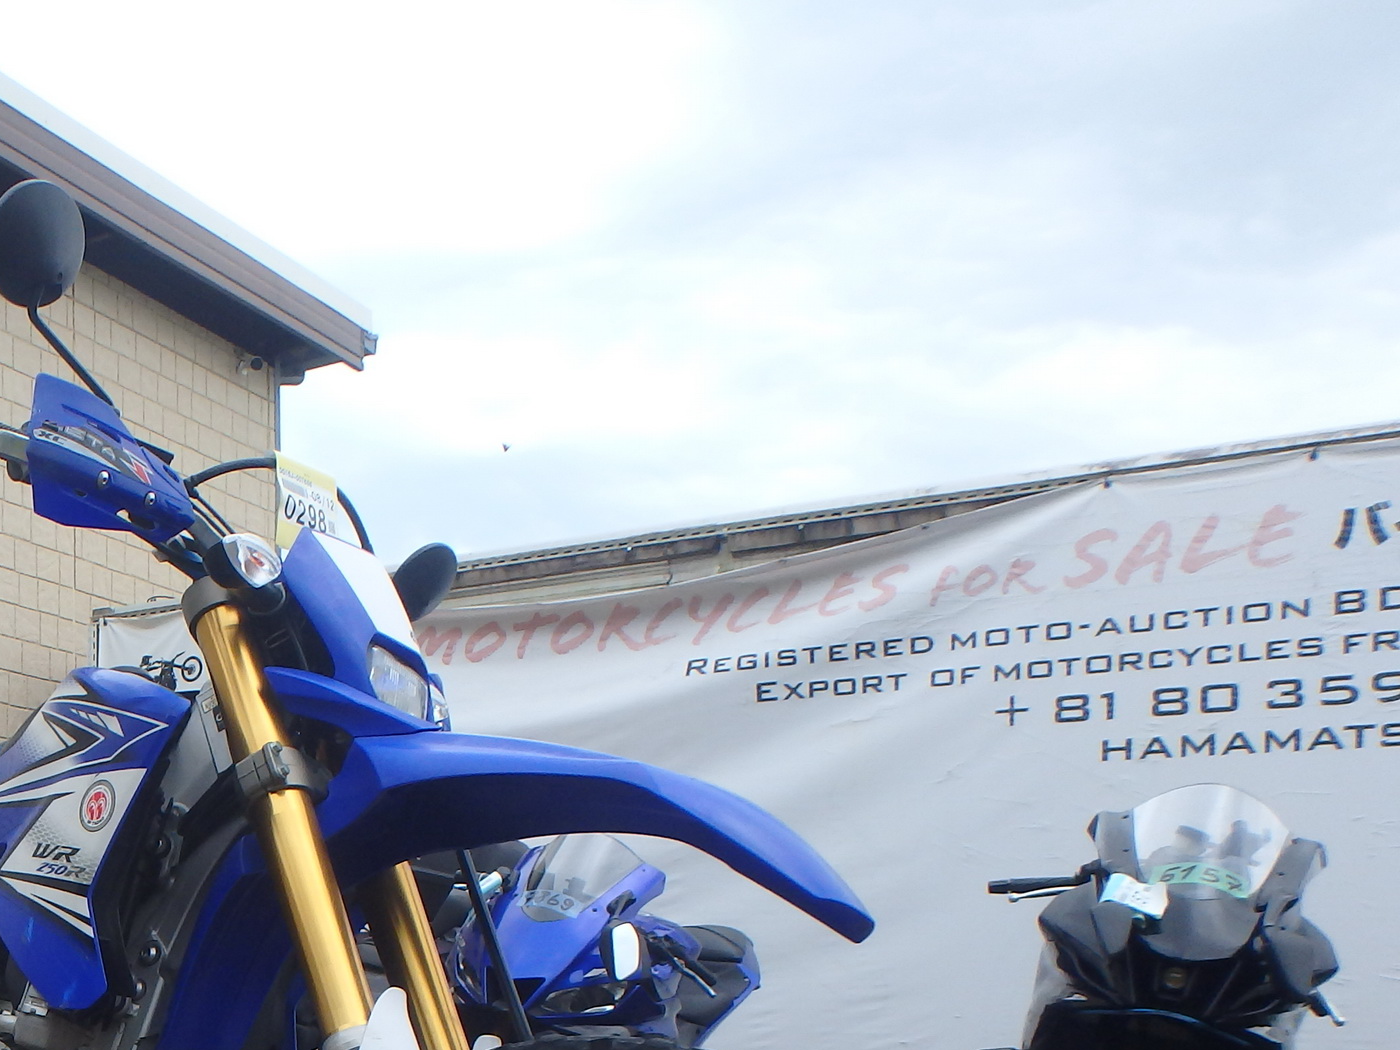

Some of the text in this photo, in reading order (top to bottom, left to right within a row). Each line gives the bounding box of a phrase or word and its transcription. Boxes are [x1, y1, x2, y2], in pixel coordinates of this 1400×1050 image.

[284, 493, 328, 534] 0298
[417, 504, 1306, 666] MOTORCYCLES FOR SALE
[685, 634, 934, 677] REGISTERED
[950, 598, 1311, 651] MOTO-AUCTION
[756, 672, 908, 702] EXPORT
[930, 665, 981, 688] OF
[993, 637, 1323, 682] MOTORCYCLES
[1054, 691, 1115, 723] 81
[1151, 682, 1239, 717] 80
[1101, 722, 1400, 762] HAMAMATS
[31, 842, 81, 863] WR
[35, 861, 86, 879] 250R
